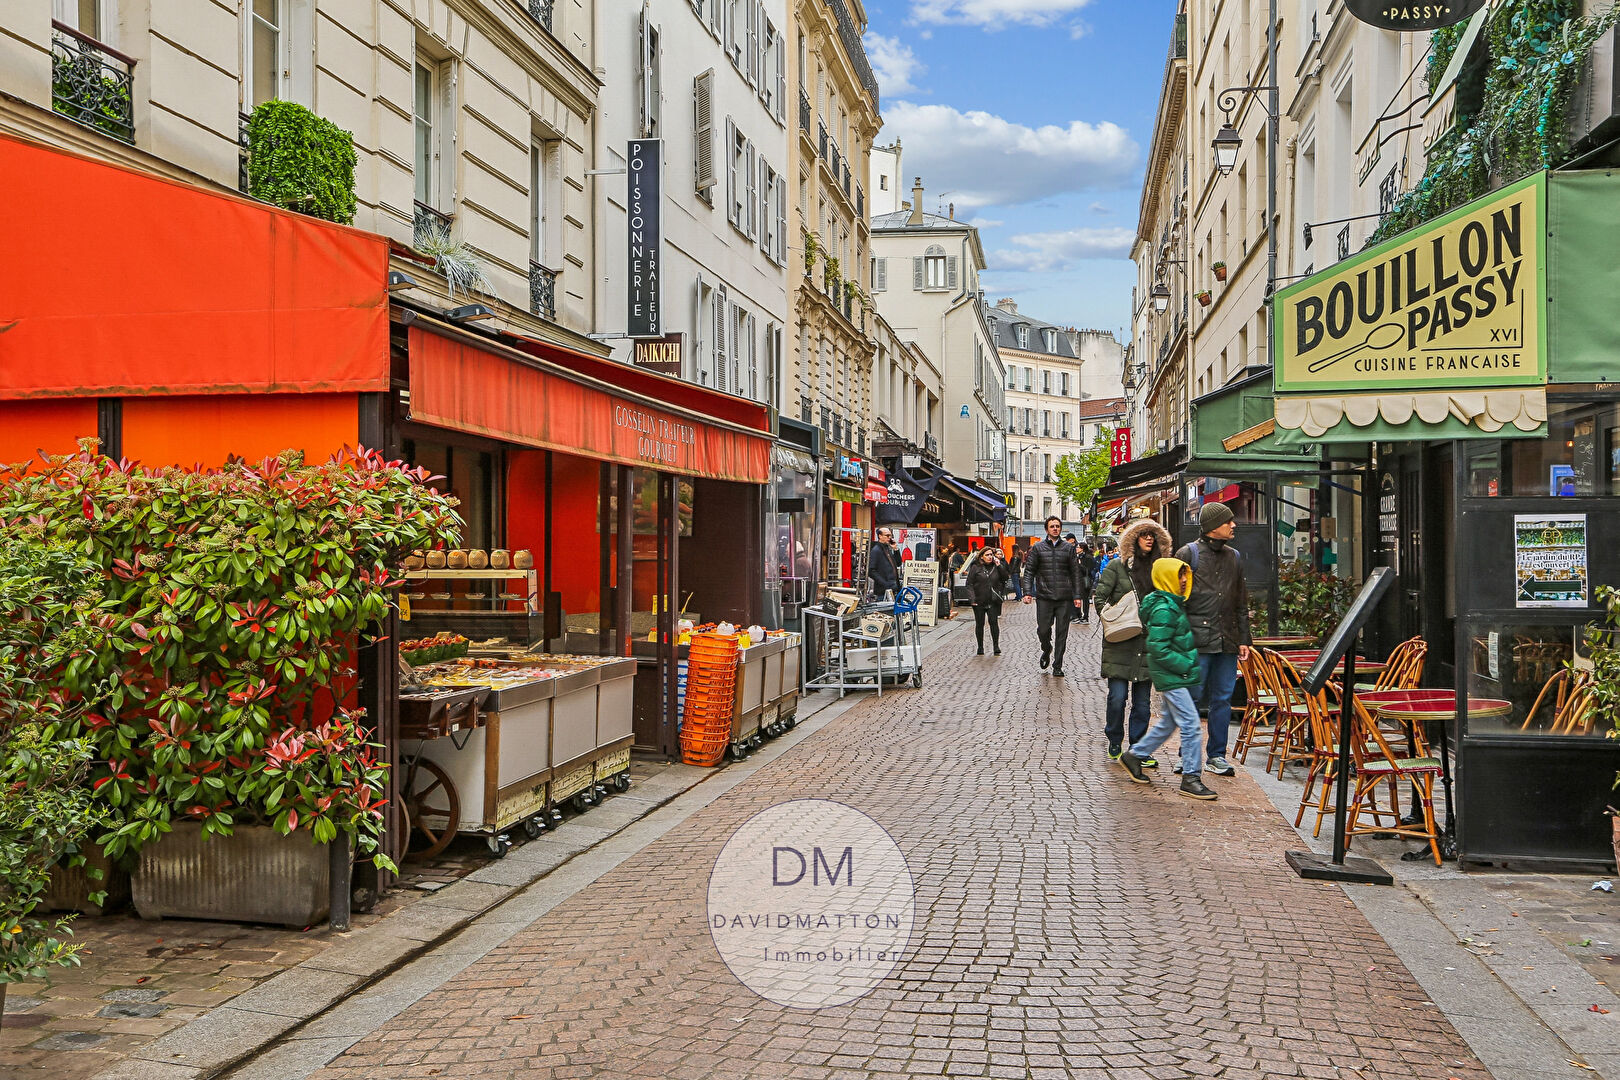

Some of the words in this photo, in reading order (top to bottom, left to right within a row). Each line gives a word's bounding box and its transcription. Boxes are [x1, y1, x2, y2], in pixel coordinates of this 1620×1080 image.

[1390, 6, 1443, 20] PASSY
[631, 144, 643, 317] POISSONNERIE
[1294, 202, 1524, 357] BOUILLON
[649, 250, 657, 333] TRAITEUR
[1407, 259, 1523, 351] PASSY
[1490, 328, 1517, 343] XVI
[636, 343, 680, 363] DAIKICHI
[1354, 356, 1417, 372] CUISINE
[1427, 353, 1521, 371] FRANCAISE
[615, 405, 656, 434] GOSSELIN
[658, 419, 695, 445] TRAITEUR
[638, 436, 677, 463] GOURMET
[887, 493, 915, 501] OUCHERS
[1533, 553, 1556, 563] jardin
[1557, 553, 1568, 561] du
